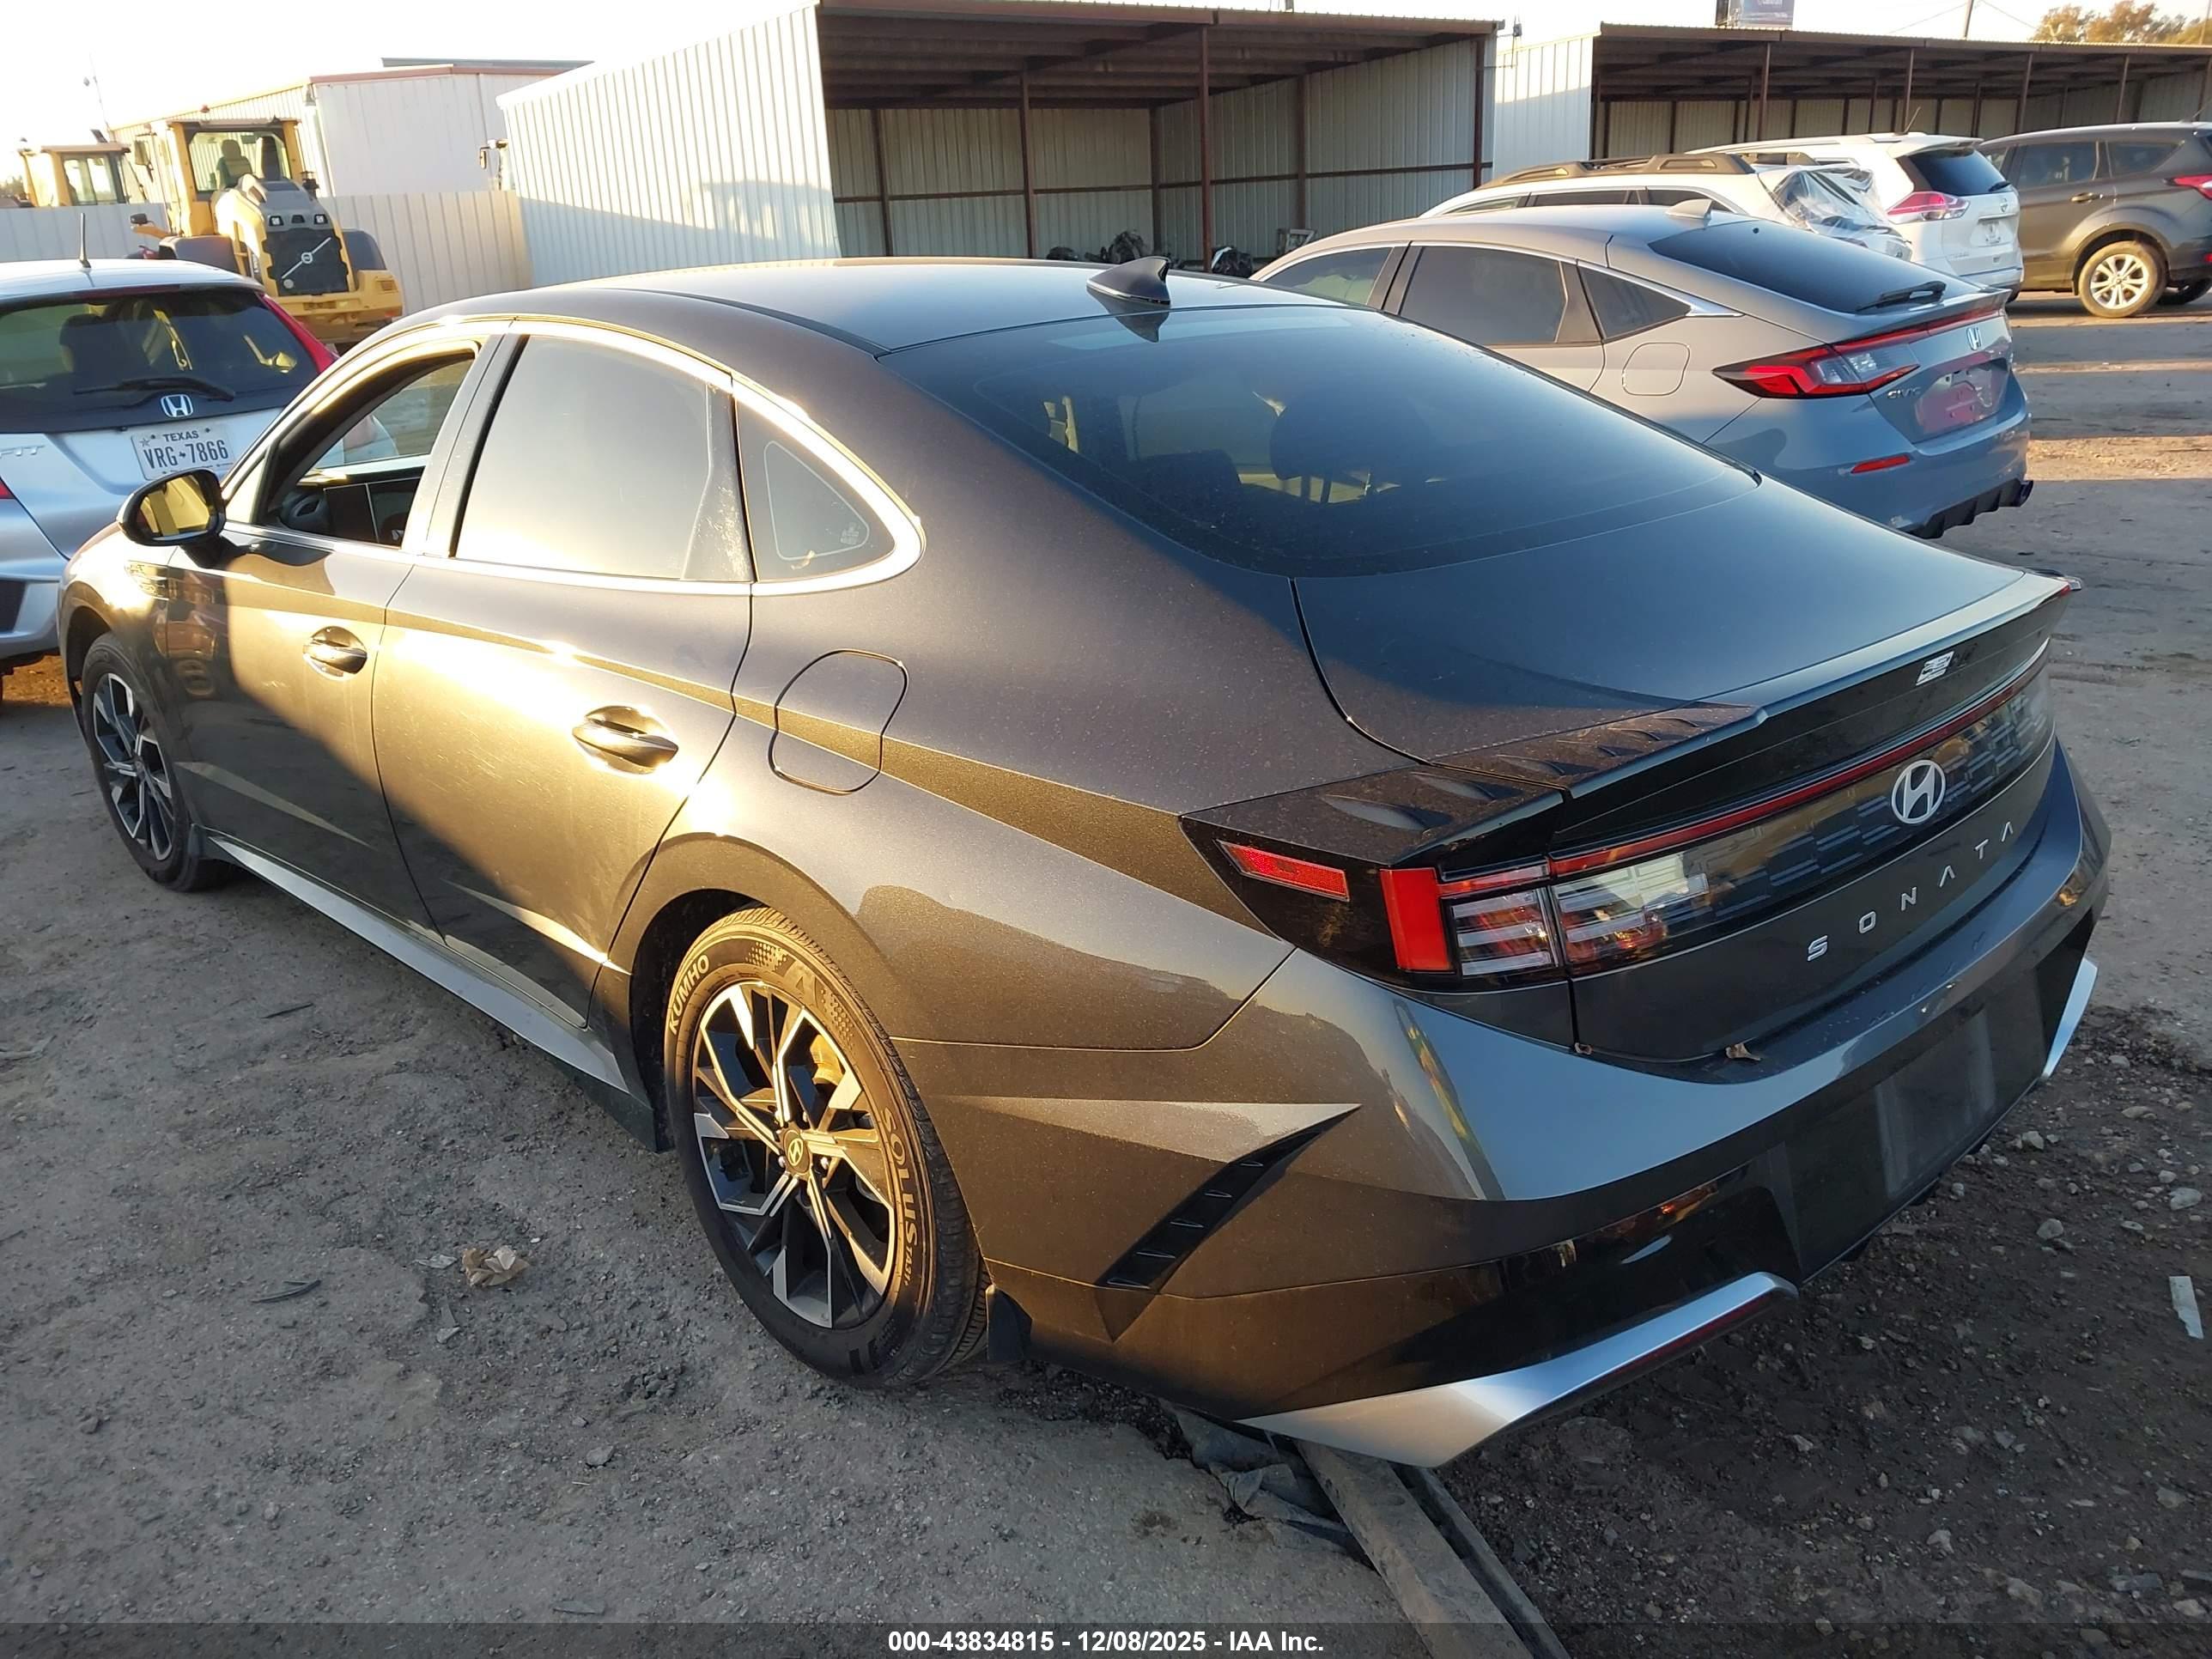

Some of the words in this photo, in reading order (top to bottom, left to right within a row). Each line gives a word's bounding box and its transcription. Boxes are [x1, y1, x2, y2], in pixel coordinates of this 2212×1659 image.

[163, 430, 199, 442] TEXAS
[1807, 822, 2014, 961] SONATA
[670, 955, 709, 1036] KUMHO
[881, 1107, 917, 1245] SOLUS
